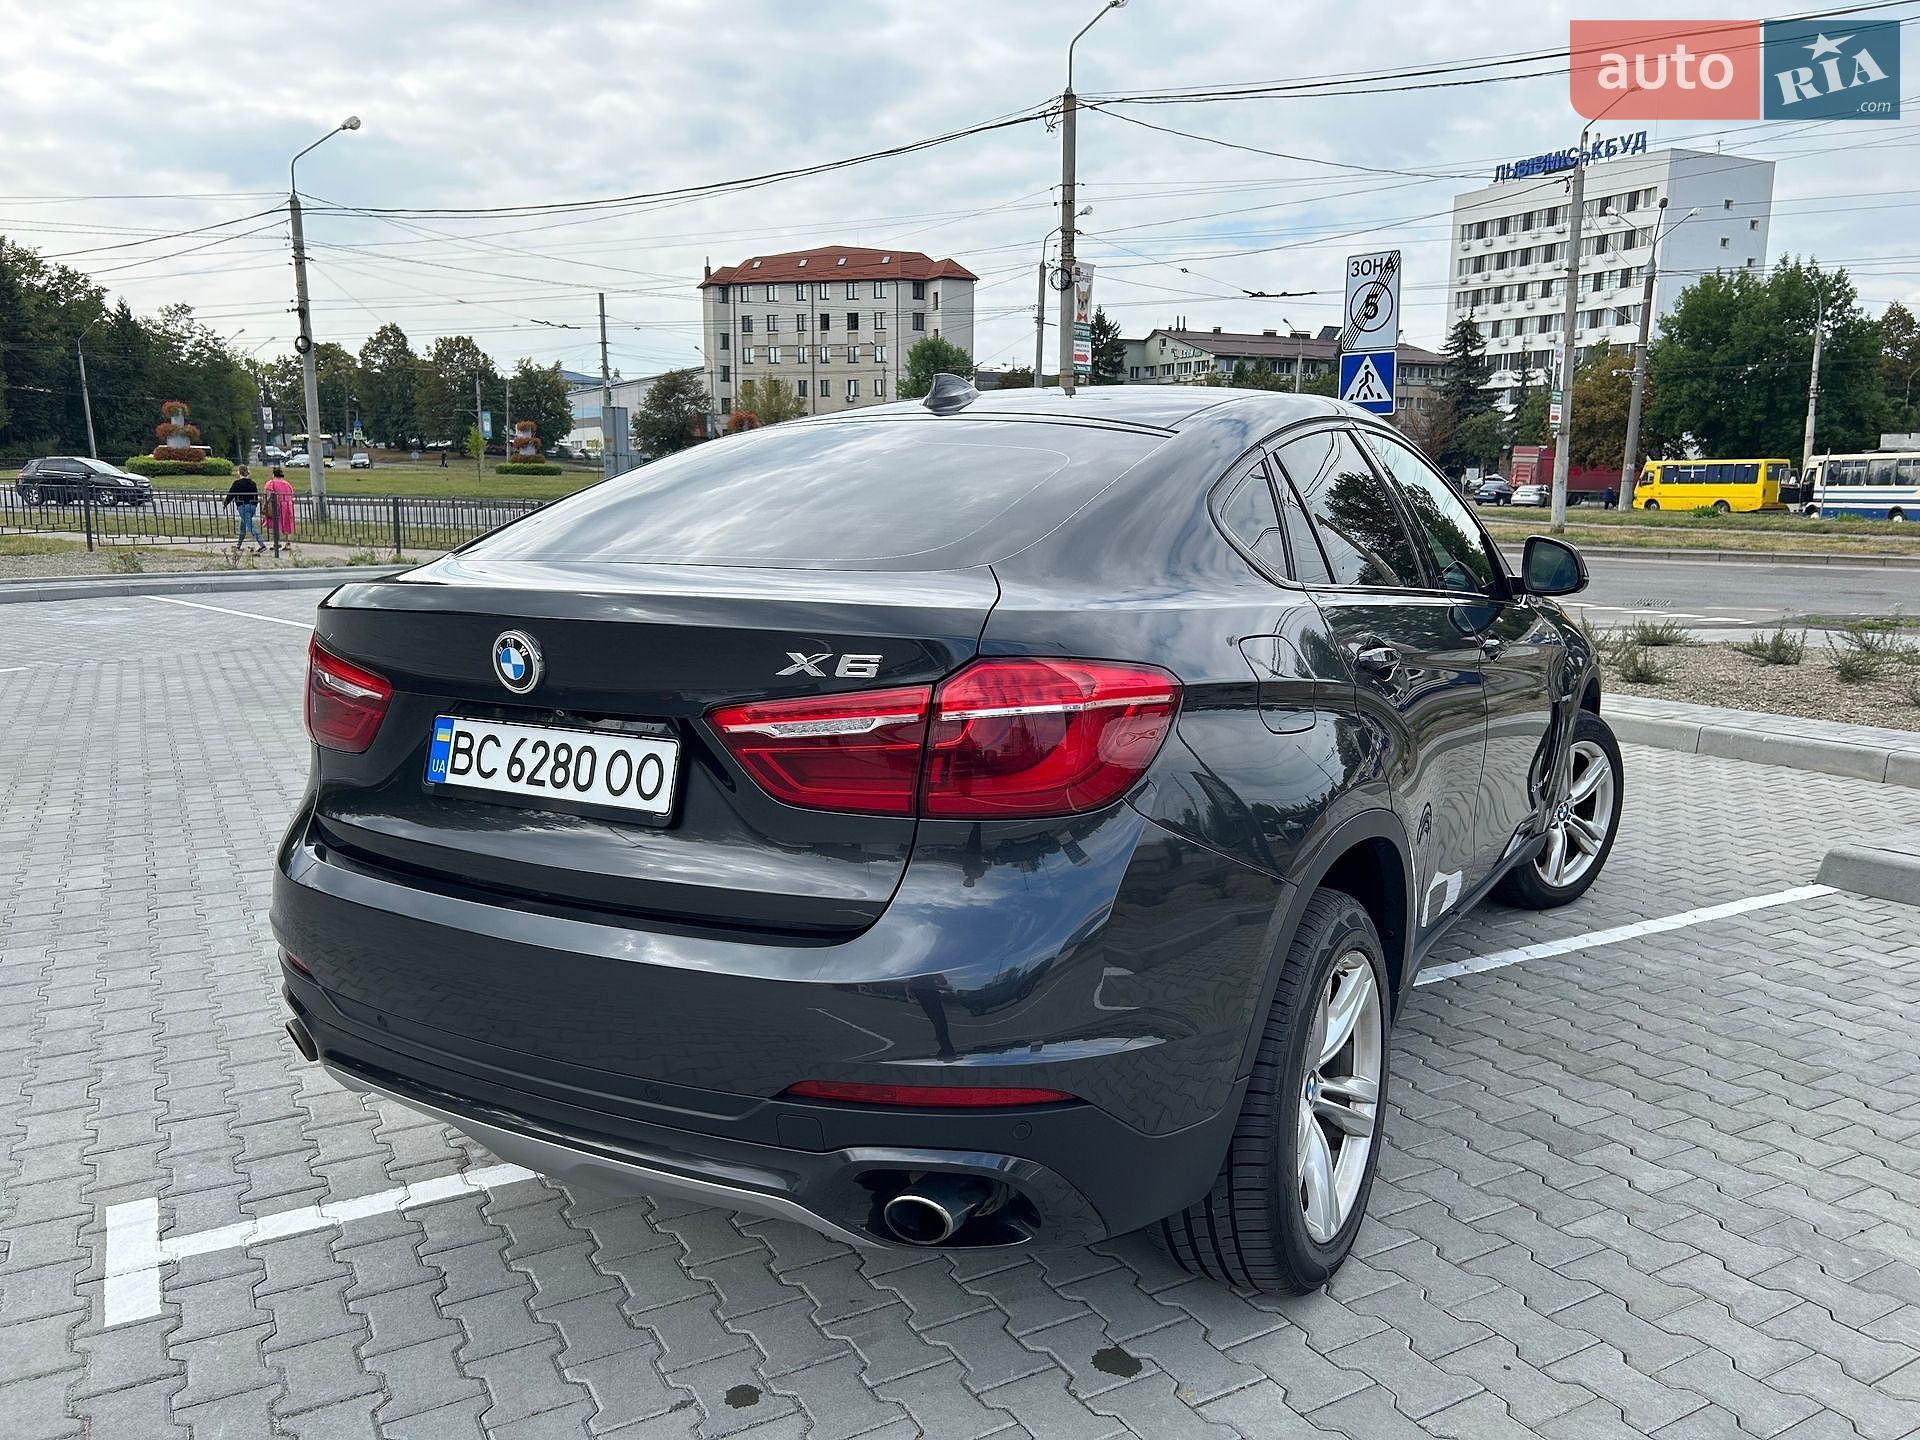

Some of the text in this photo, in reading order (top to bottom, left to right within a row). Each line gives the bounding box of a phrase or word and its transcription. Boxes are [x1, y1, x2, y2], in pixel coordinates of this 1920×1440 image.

[1351, 257, 1395, 278] ЗОНА
[497, 638, 529, 657] BMW
[775, 652, 885, 678] X6
[432, 758, 446, 774] UA
[450, 730, 665, 801] BC 6280 OO
